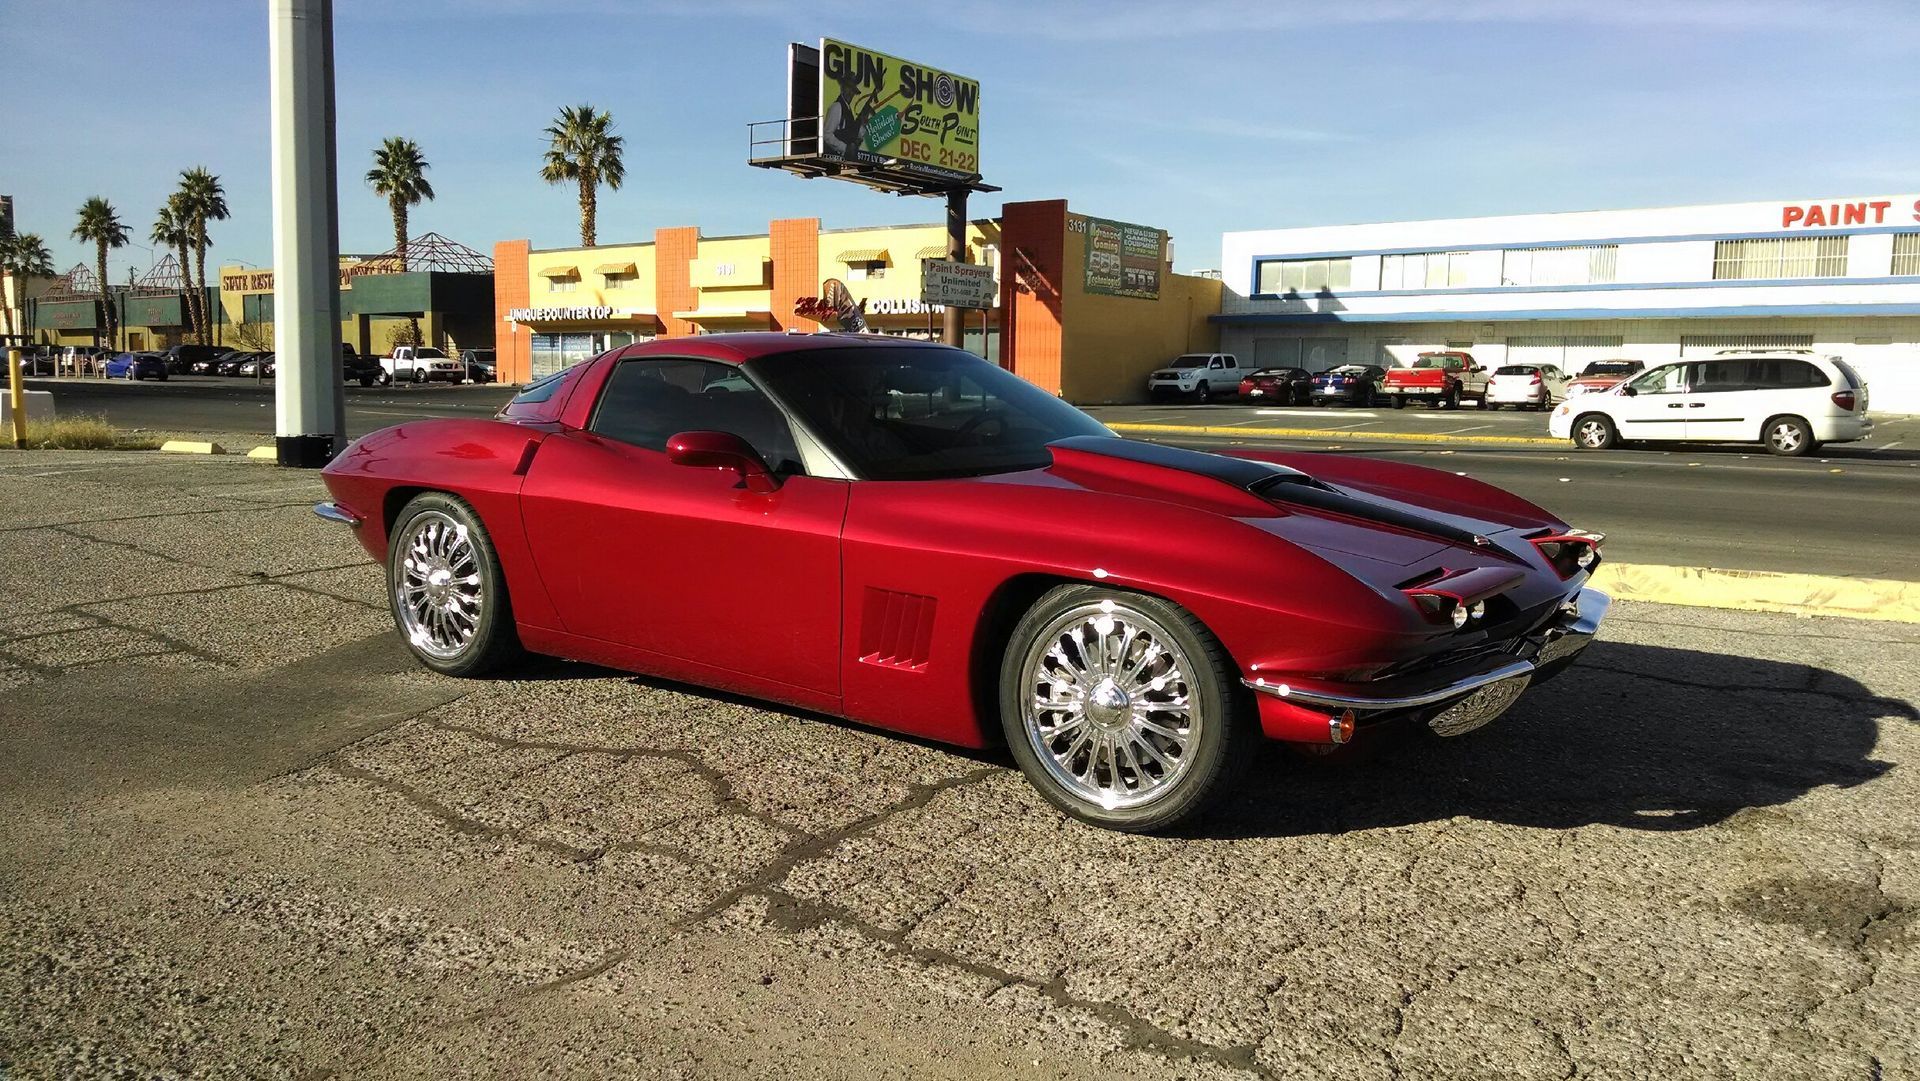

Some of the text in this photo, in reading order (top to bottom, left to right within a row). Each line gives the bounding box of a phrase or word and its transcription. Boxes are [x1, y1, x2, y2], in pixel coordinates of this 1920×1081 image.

[824, 44, 976, 115] GUN SHOW
[901, 138, 975, 172] DEC 21-22
[1782, 201, 1891, 228] PAINT
[1068, 219, 1087, 233] 3131
[1093, 237, 1118, 253] Gaming
[930, 262, 991, 278] Paint Sprayers
[223, 275, 248, 291] STATE
[941, 276, 981, 287] Unlimited
[510, 307, 543, 321] UNIQUE
